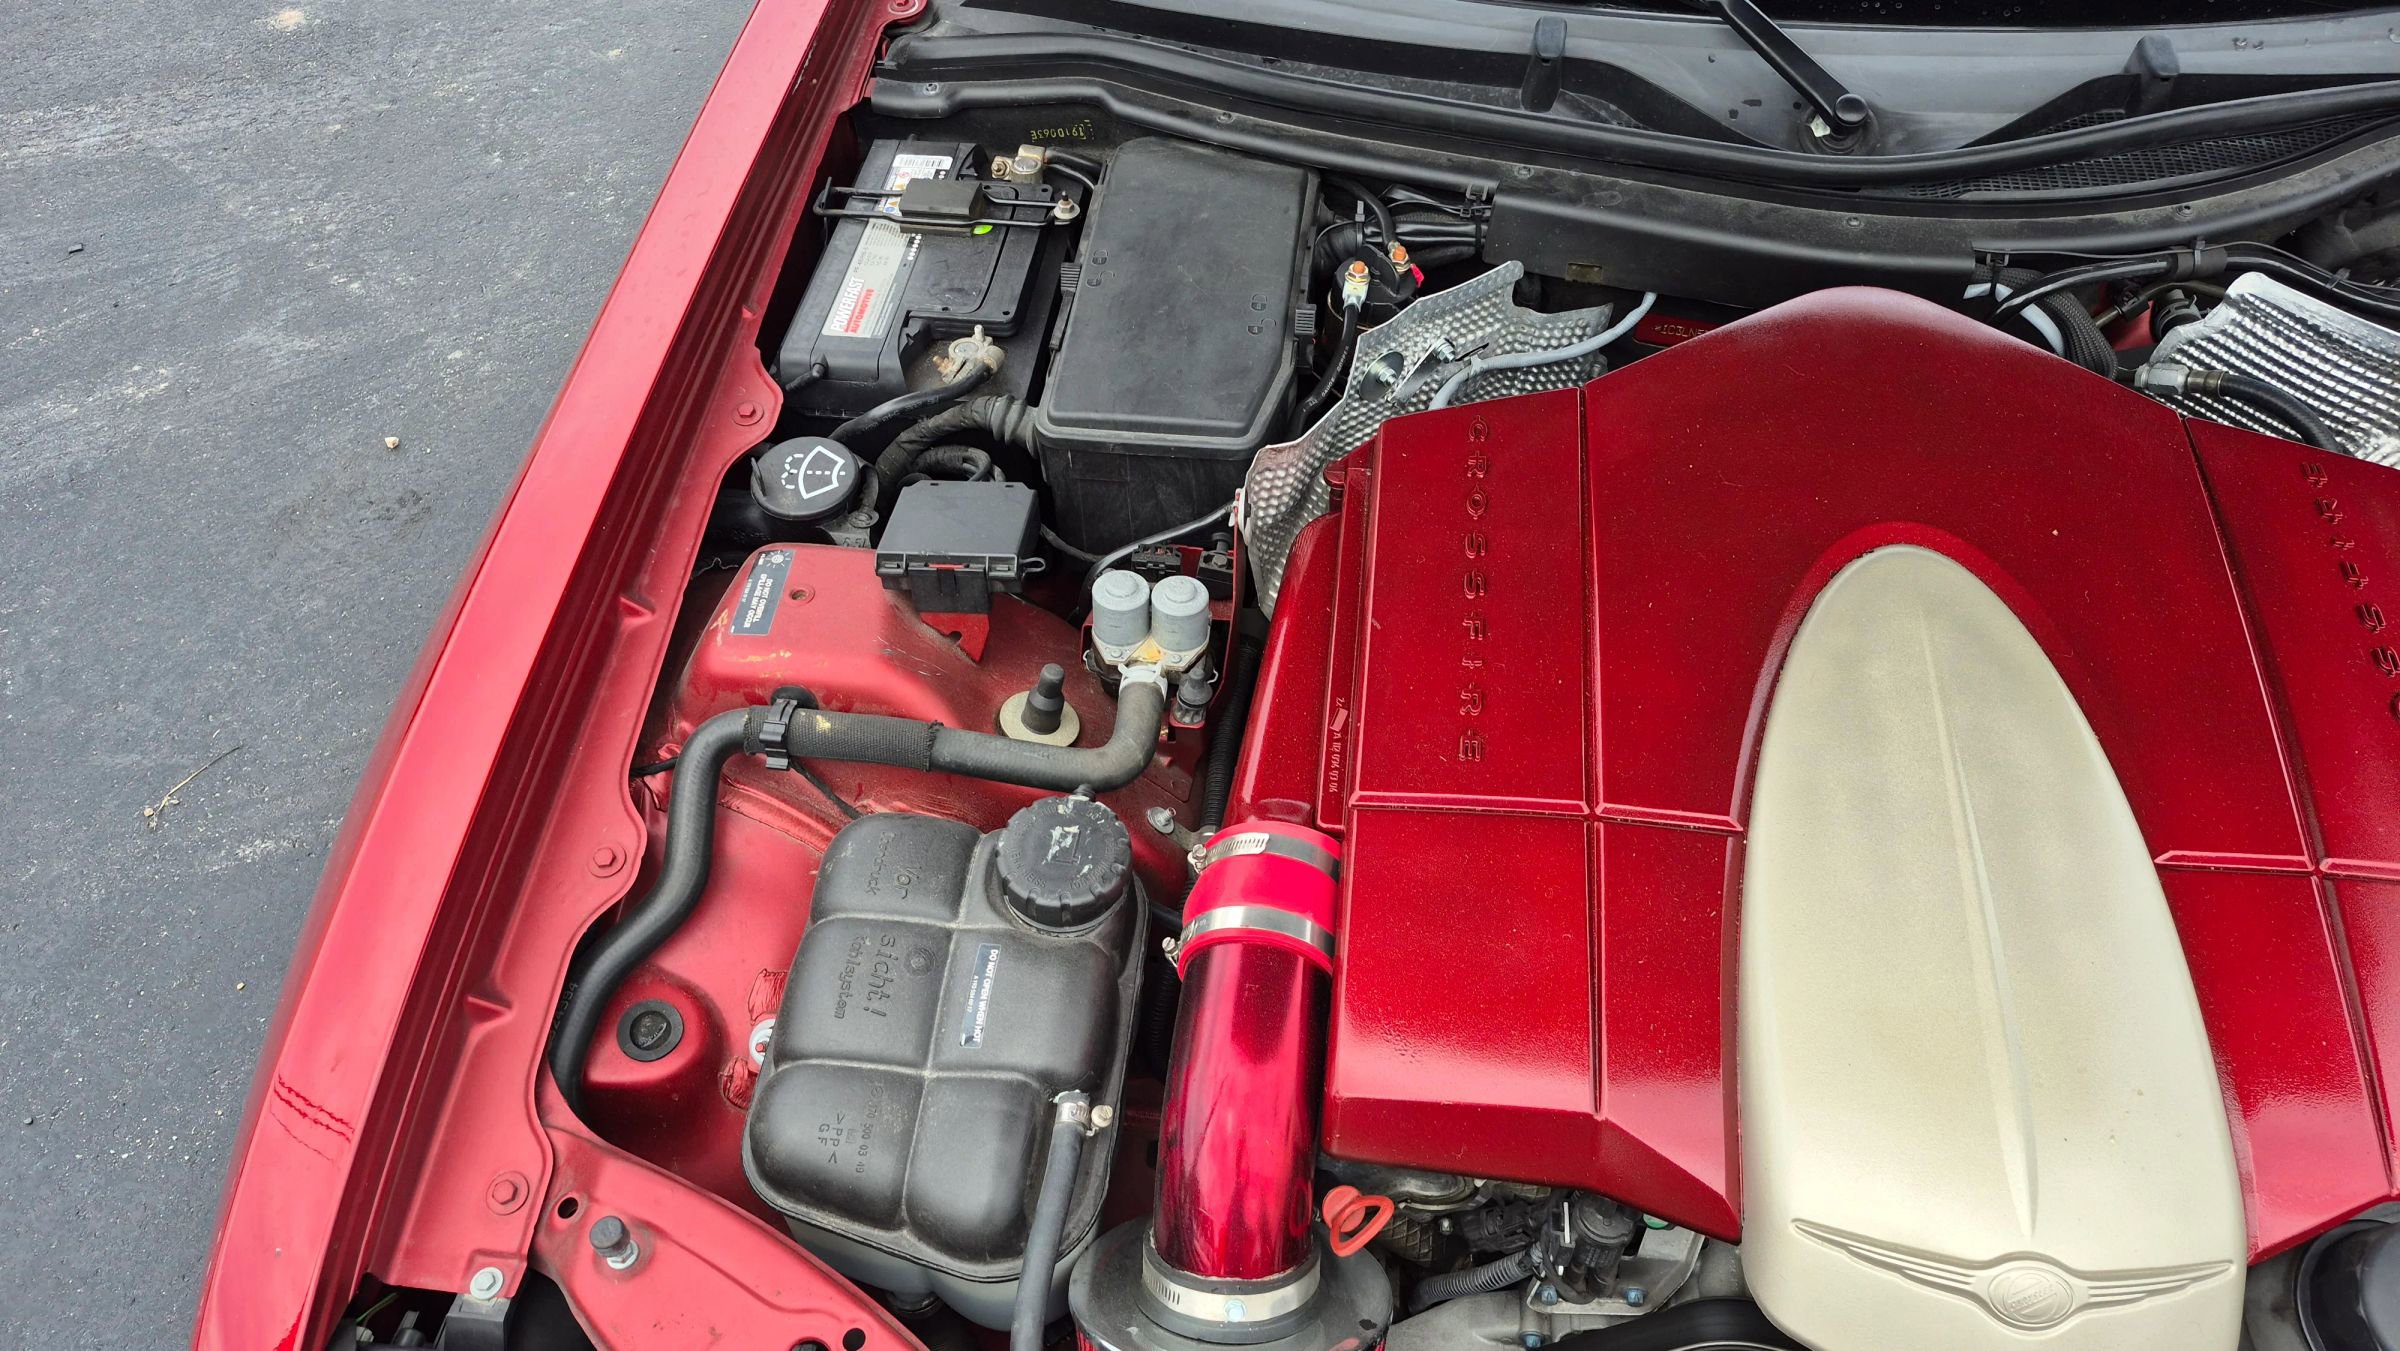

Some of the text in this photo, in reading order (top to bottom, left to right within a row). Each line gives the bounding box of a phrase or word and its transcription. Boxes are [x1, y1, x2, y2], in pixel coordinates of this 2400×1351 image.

[830, 276, 865, 331] POWERFAST
[849, 288, 875, 334] AUTOMOTIVE
[750, 596, 760, 610] MAY
[752, 578, 774, 623] DO NOT OVERFILL
[753, 573, 768, 597] SPILLAGE
[1457, 415, 1488, 763] CROSSFIRE
[743, 609, 755, 628] OCCUR
[863, 866, 922, 1018] Vor sicht!
[972, 949, 999, 1043] DO NOT OPEN WHEN HOT
